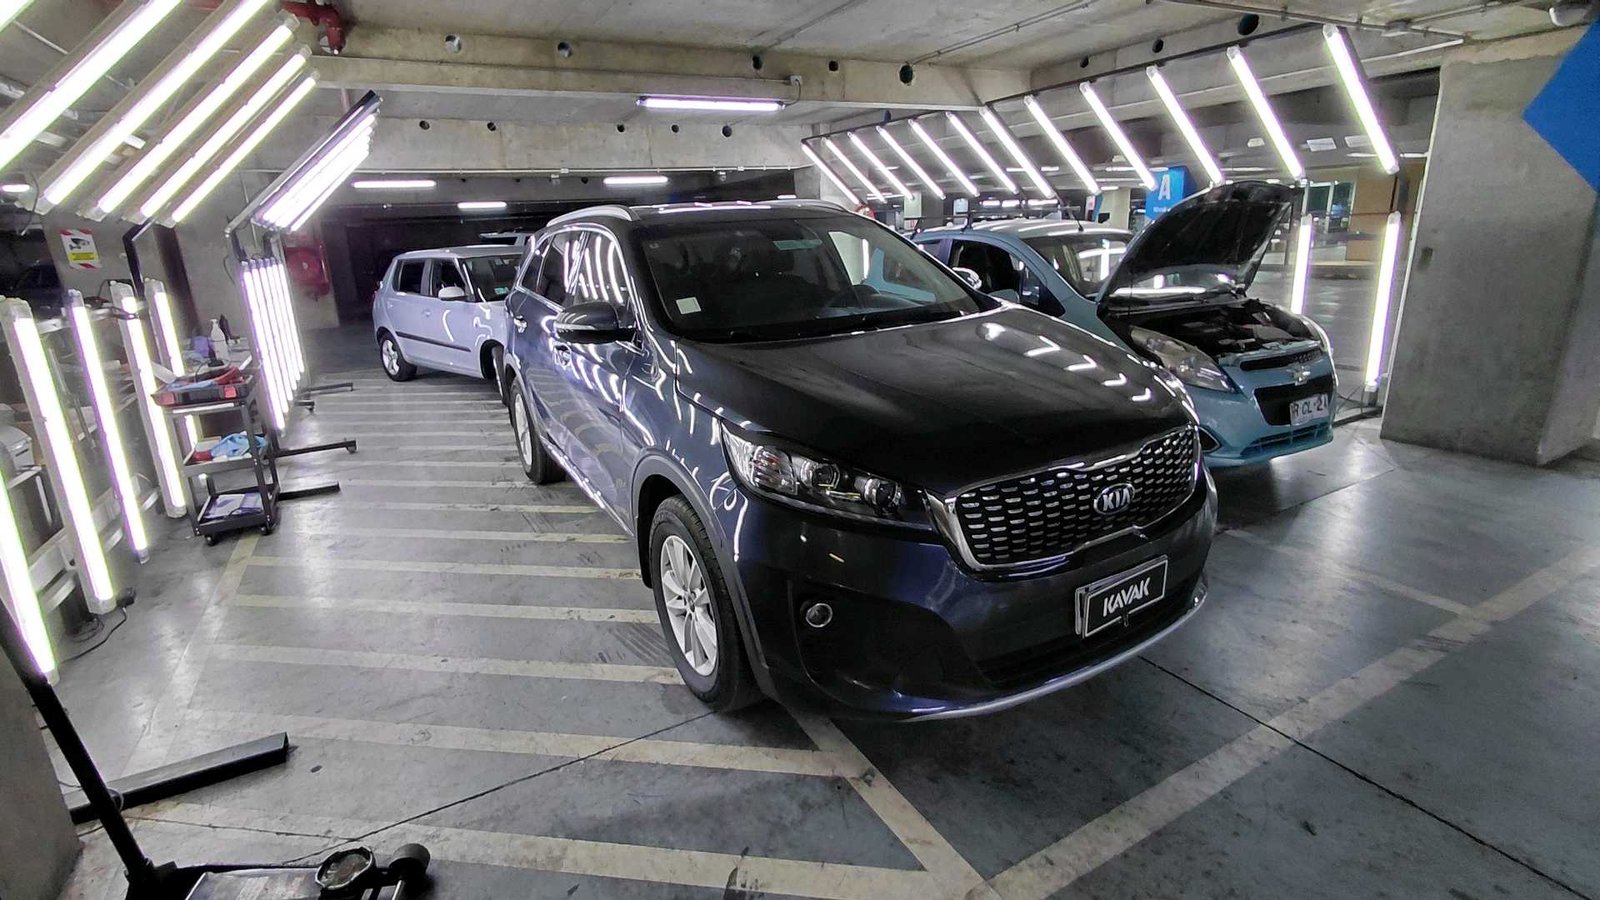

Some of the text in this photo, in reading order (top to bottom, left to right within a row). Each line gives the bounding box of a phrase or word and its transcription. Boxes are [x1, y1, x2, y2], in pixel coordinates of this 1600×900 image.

[1157, 173, 1171, 201] A
[1102, 487, 1131, 511] KIA
[1103, 577, 1151, 617] KAVAK
